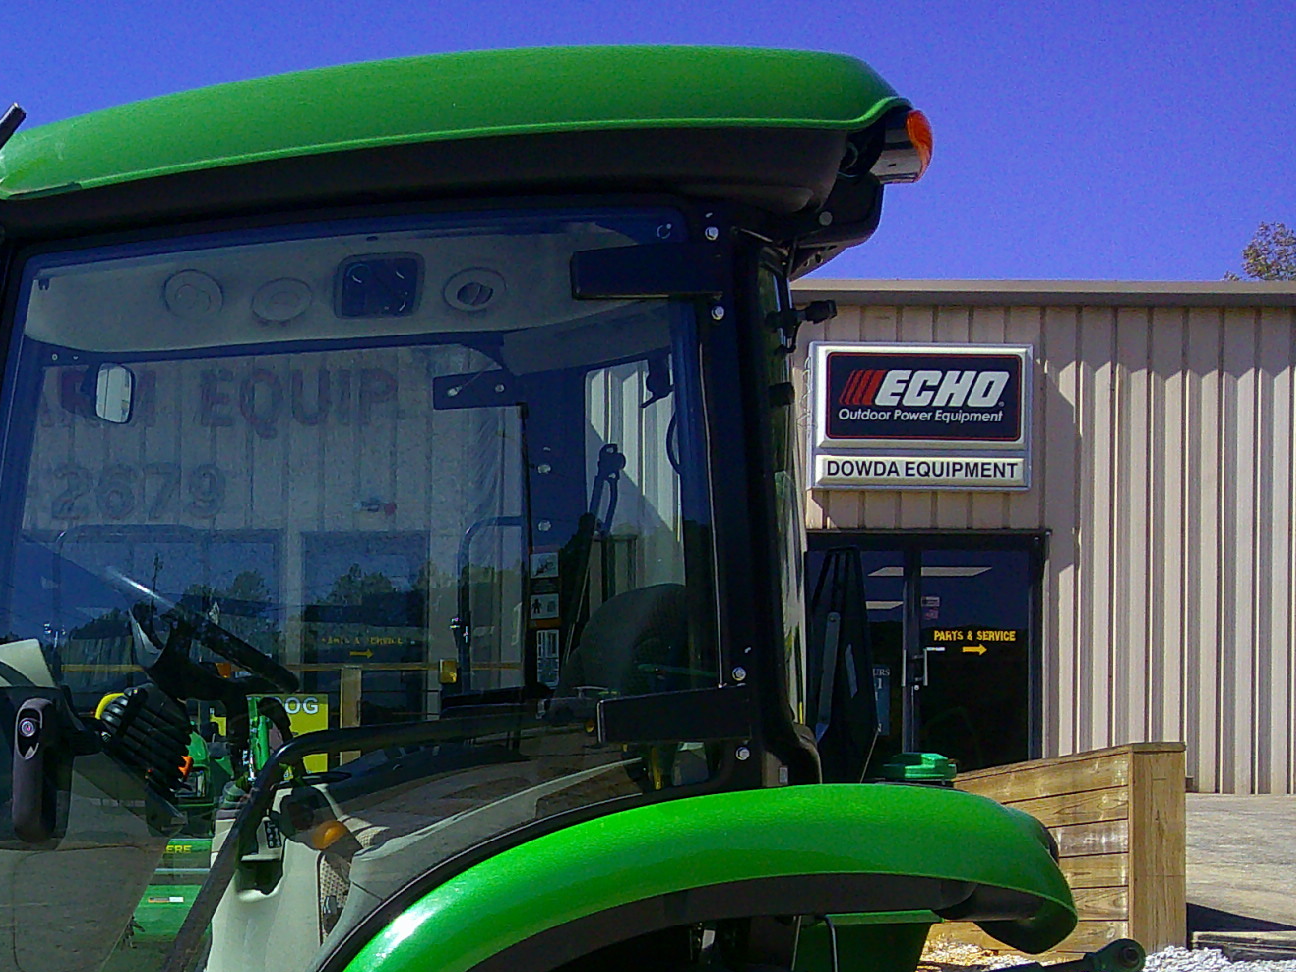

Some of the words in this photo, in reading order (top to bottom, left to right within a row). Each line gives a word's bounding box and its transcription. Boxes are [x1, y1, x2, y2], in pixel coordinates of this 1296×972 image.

[874, 369, 1010, 407] ECHO
[839, 408, 891, 420] Outdoor
[894, 409, 932, 421] Power
[935, 409, 1003, 423] Equipment
[827, 461, 899, 477] DOWDA
[906, 461, 1018, 478] EQUIPMENT
[933, 630, 964, 642] PARTS
[967, 630, 973, 641] &
[976, 630, 1017, 642] SERVICE
